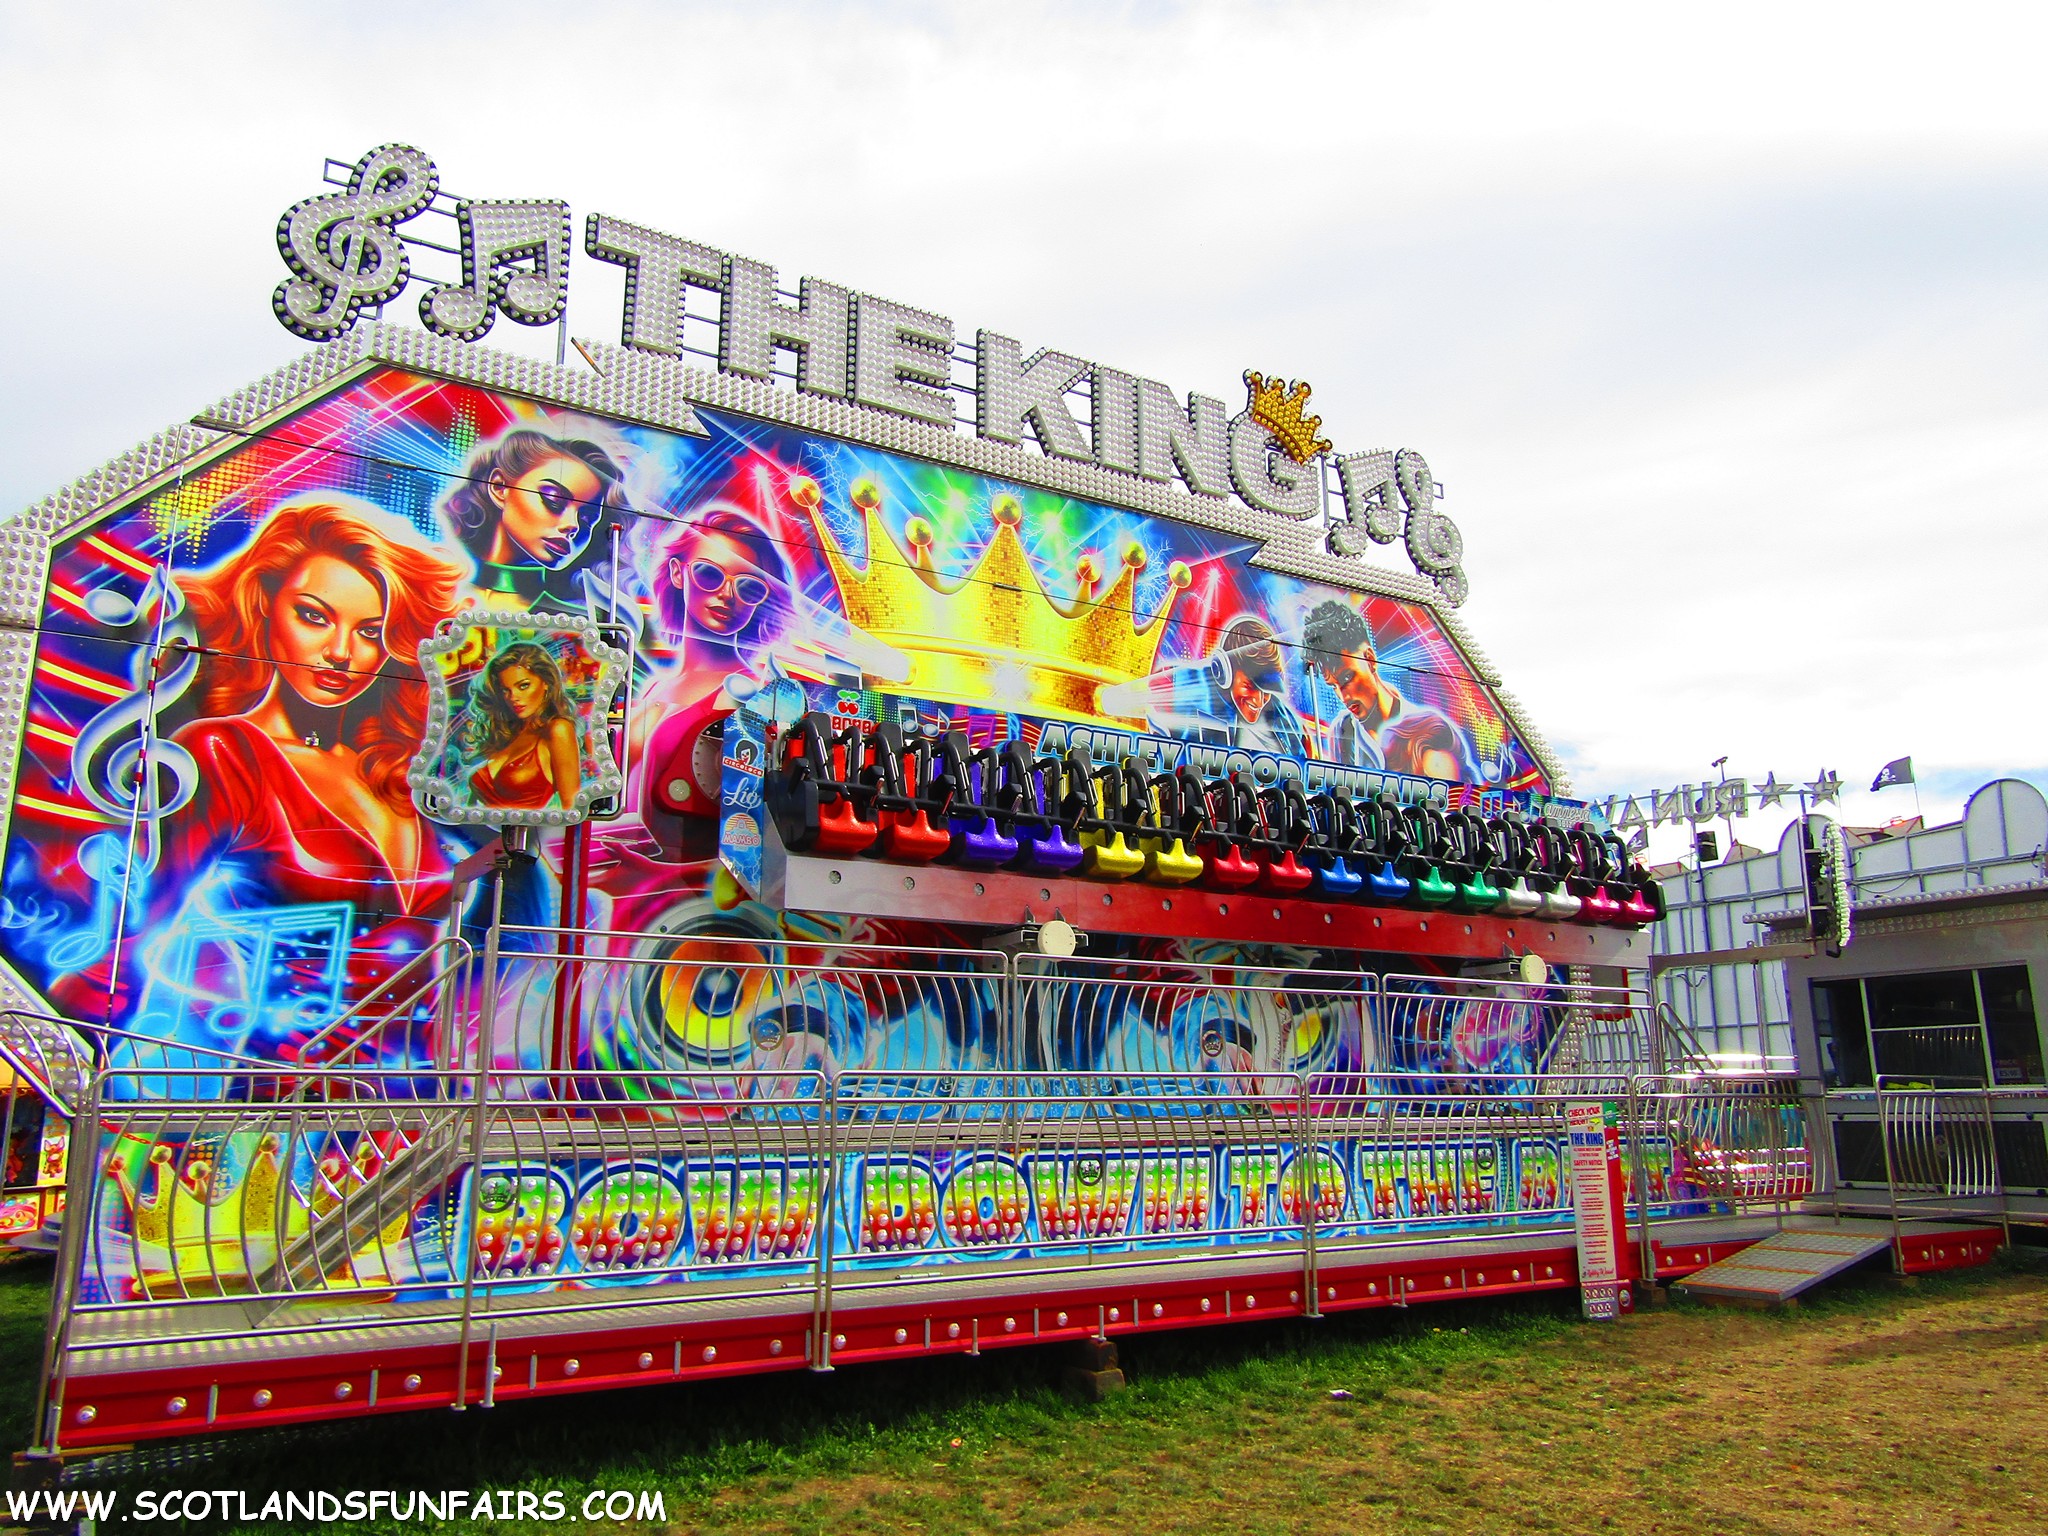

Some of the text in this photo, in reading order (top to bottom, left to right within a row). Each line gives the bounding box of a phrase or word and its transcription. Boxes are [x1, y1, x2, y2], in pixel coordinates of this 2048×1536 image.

[585, 212, 1321, 519] THE KING
[724, 757, 764, 777] CIRCOLOCO
[1037, 722, 1449, 811] ASHLEY WOOD FUNFAIRS
[723, 832, 761, 845] MAMBO
[1568, 1108, 1585, 1117] CHECK
[1587, 1106, 1600, 1115] YOUR
[1570, 1132, 1604, 1145] THE KING
[462, 1160, 830, 1290] BOW
[860, 1152, 1213, 1259] DOWN
[1221, 1144, 1348, 1239] TO
[1361, 1140, 1500, 1228] THE
